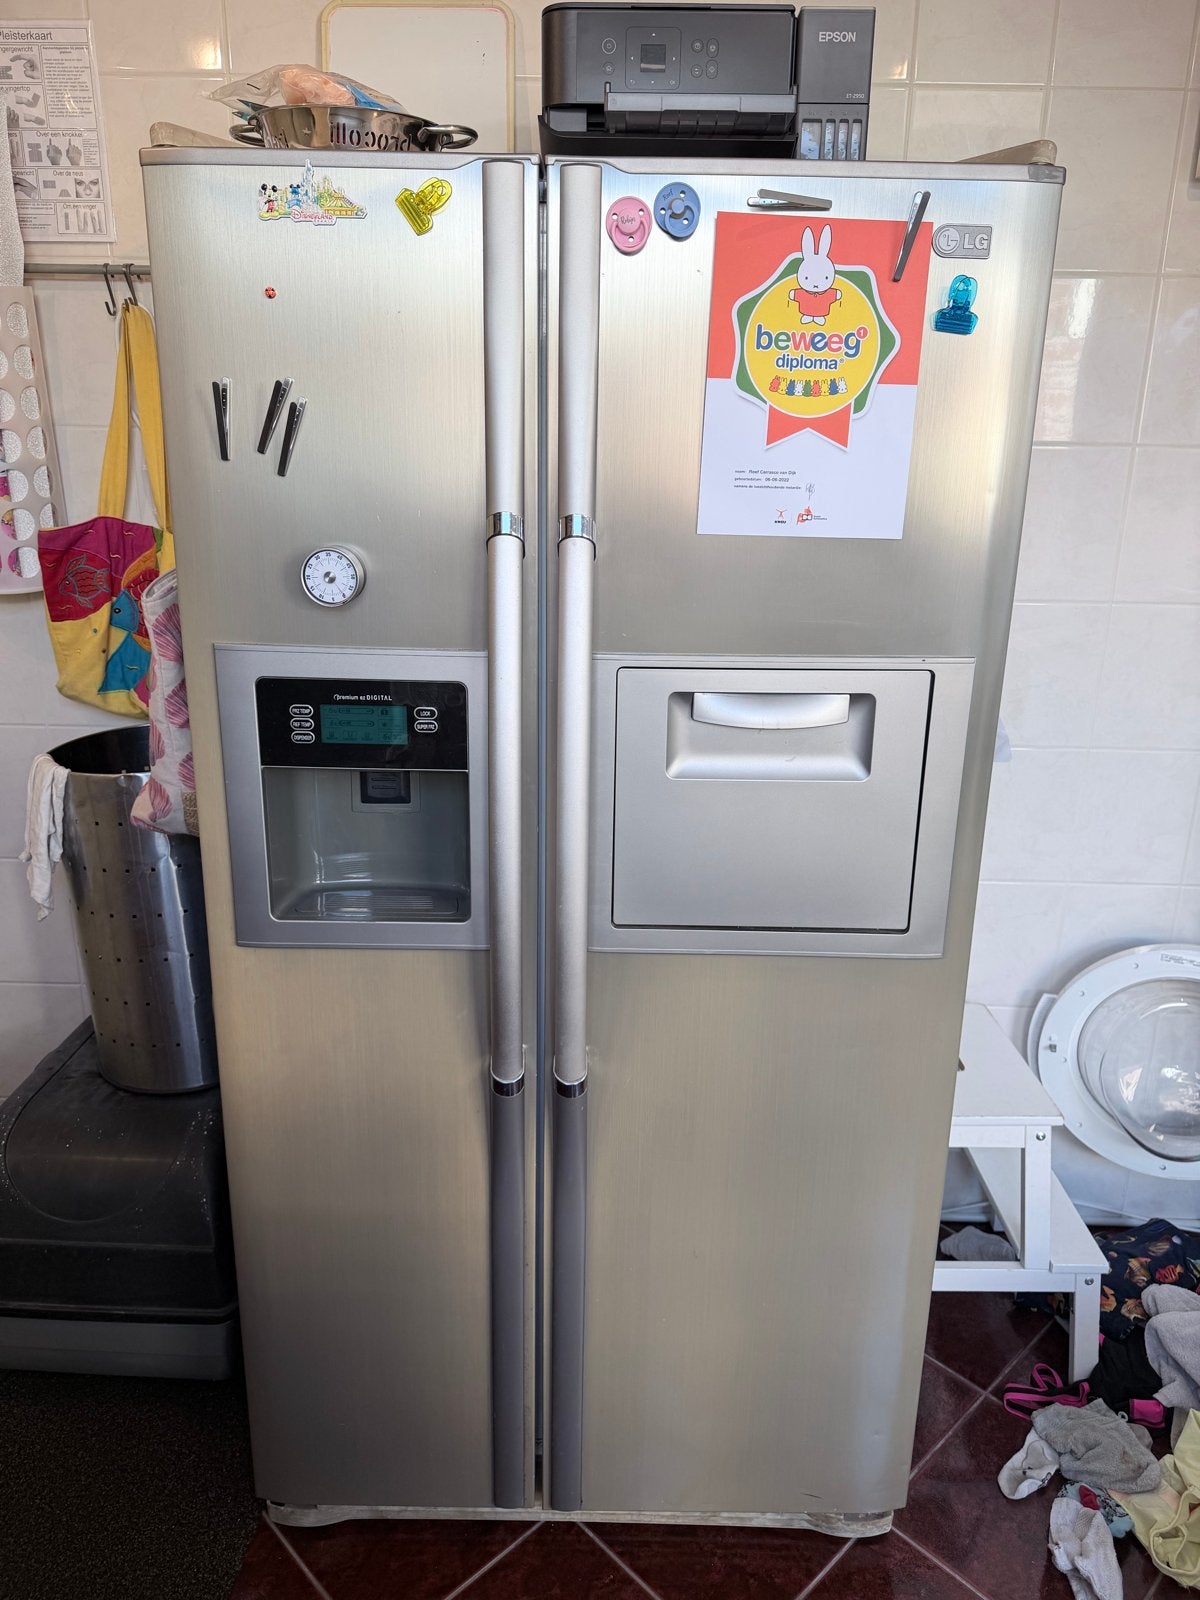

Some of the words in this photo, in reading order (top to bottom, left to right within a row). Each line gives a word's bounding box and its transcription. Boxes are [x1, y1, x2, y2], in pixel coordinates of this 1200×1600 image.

[818, 31, 857, 42] EPSON
[963, 233, 988, 250] LG
[756, 324, 861, 358] beweeg
